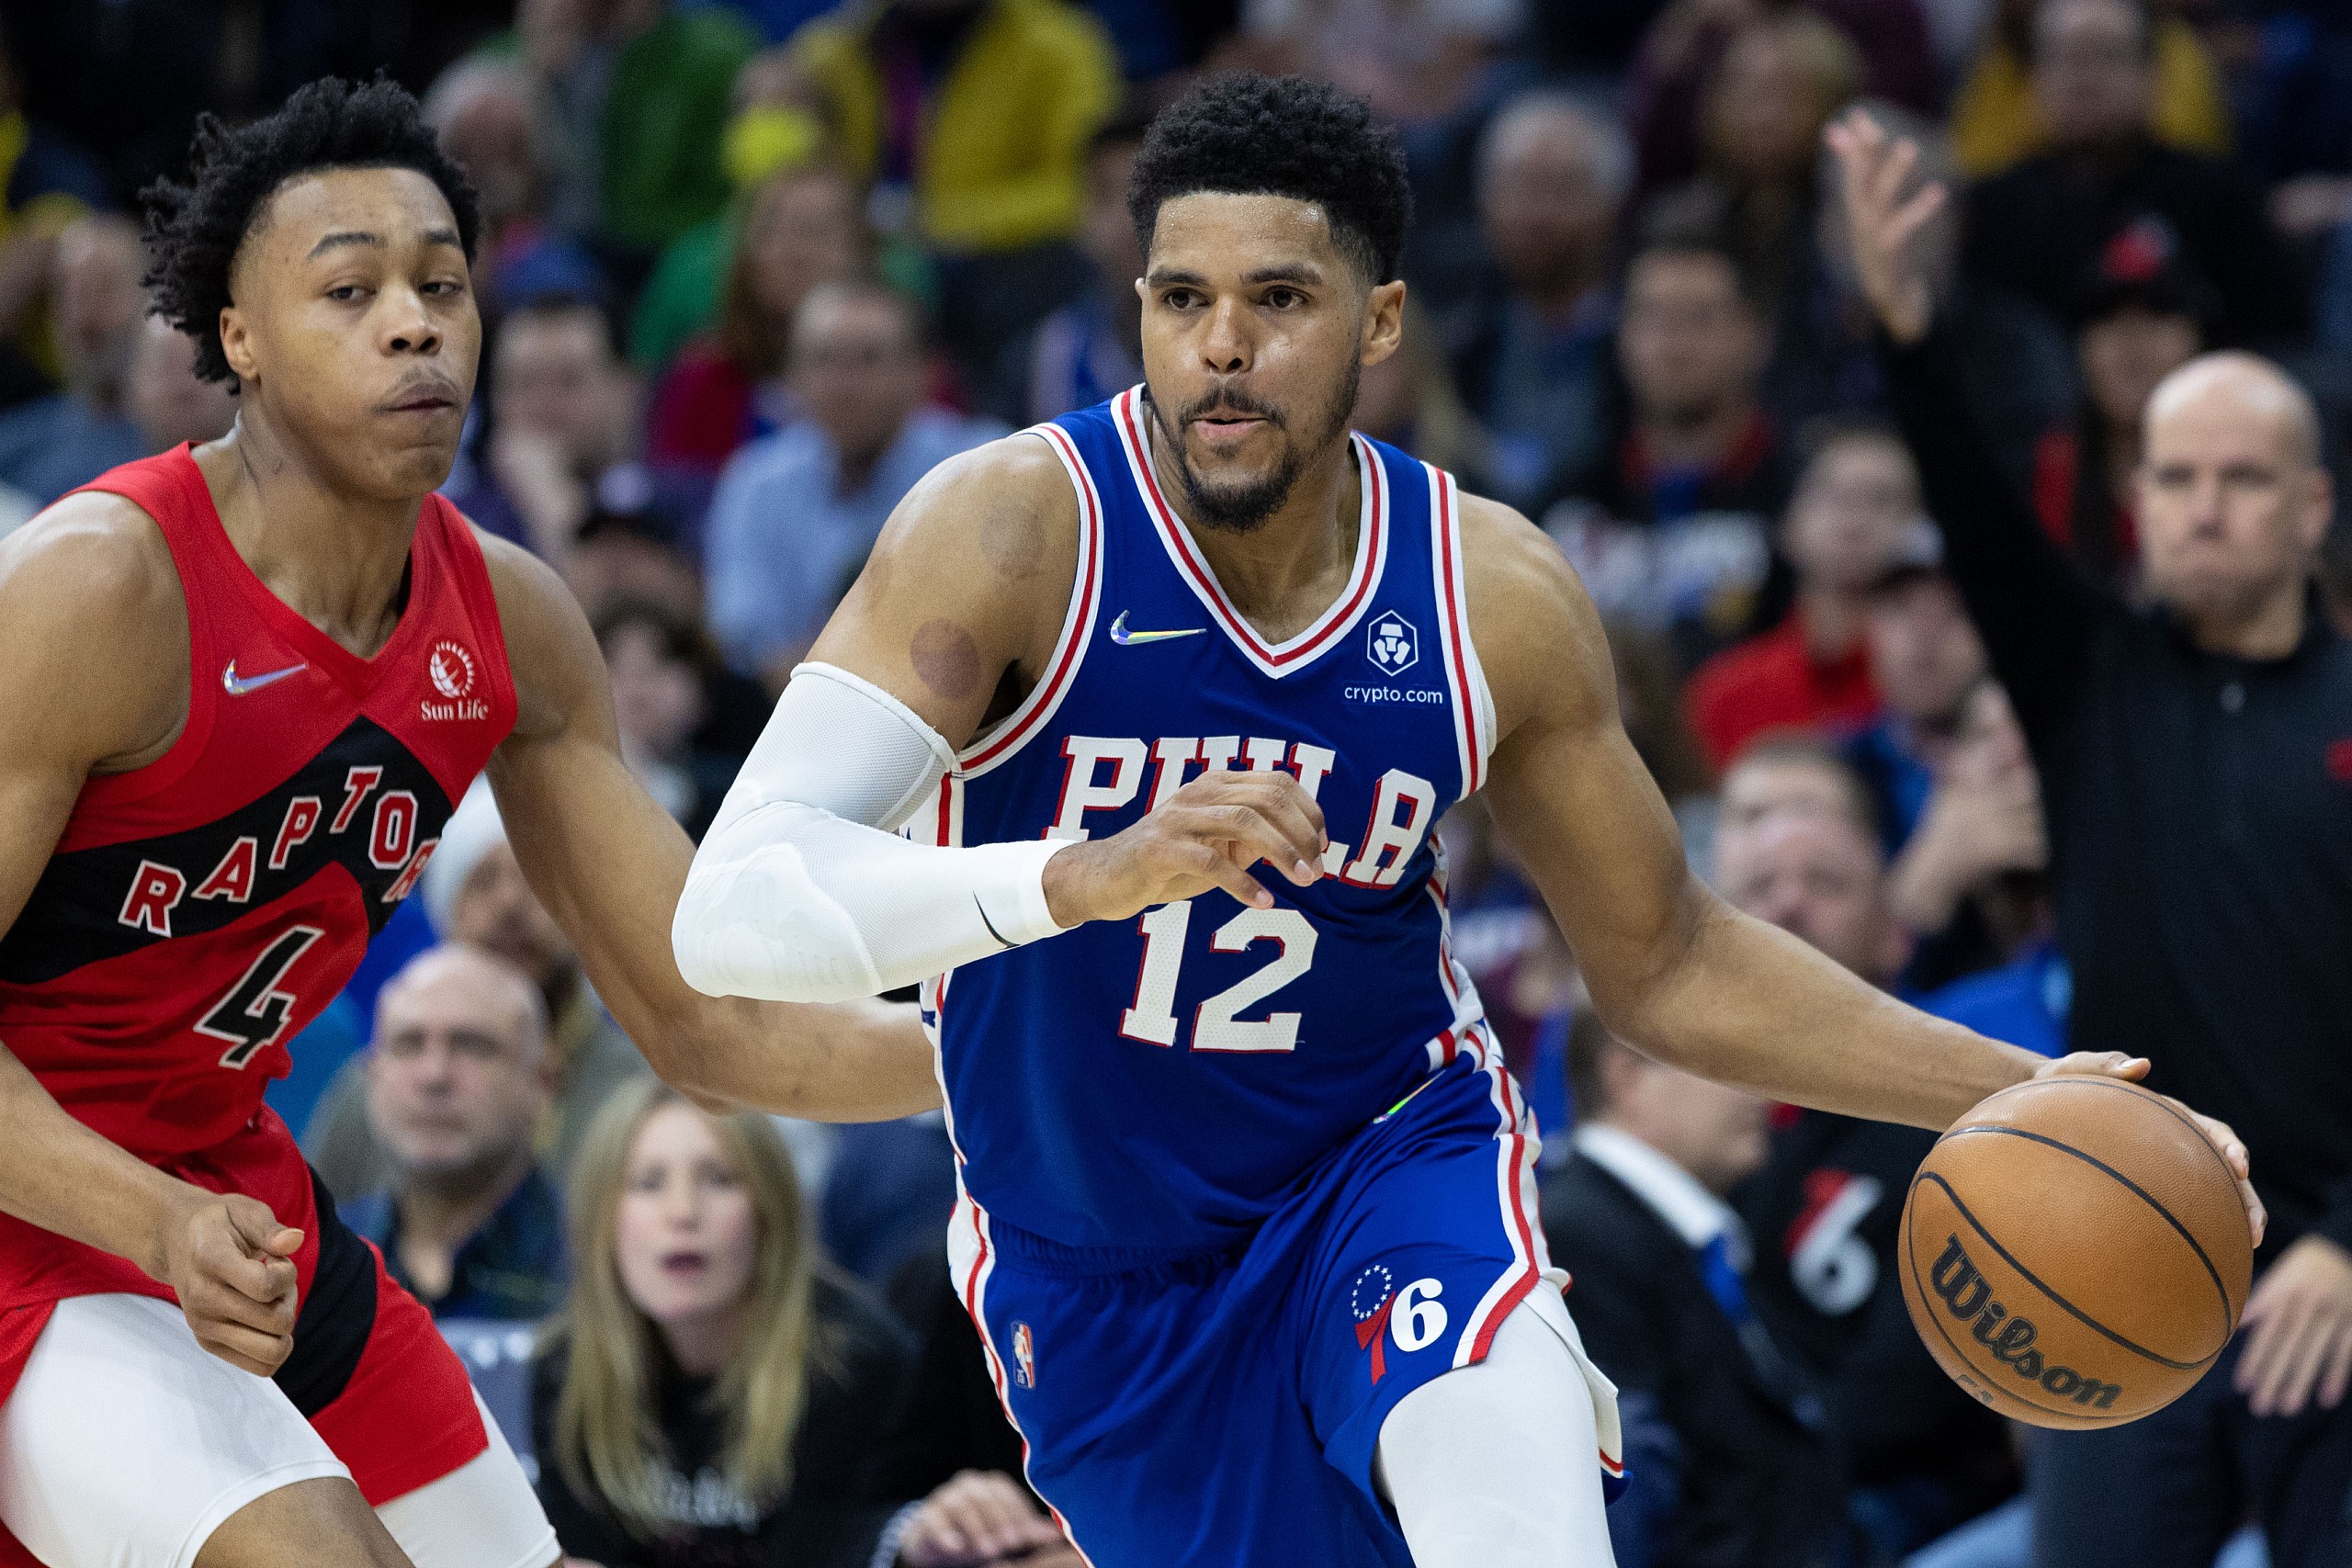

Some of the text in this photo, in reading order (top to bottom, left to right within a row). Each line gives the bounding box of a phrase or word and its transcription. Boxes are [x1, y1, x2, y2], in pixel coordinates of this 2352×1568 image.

[421, 698, 489, 721] Sun Life
[1344, 686, 1443, 705] crypto.com
[1040, 735, 1437, 890] PLA
[193, 924, 325, 1070] 4
[1118, 900, 1319, 1054] 12
[1354, 1277, 1449, 1387] 76
[1930, 1231, 2123, 1410] Wilson
